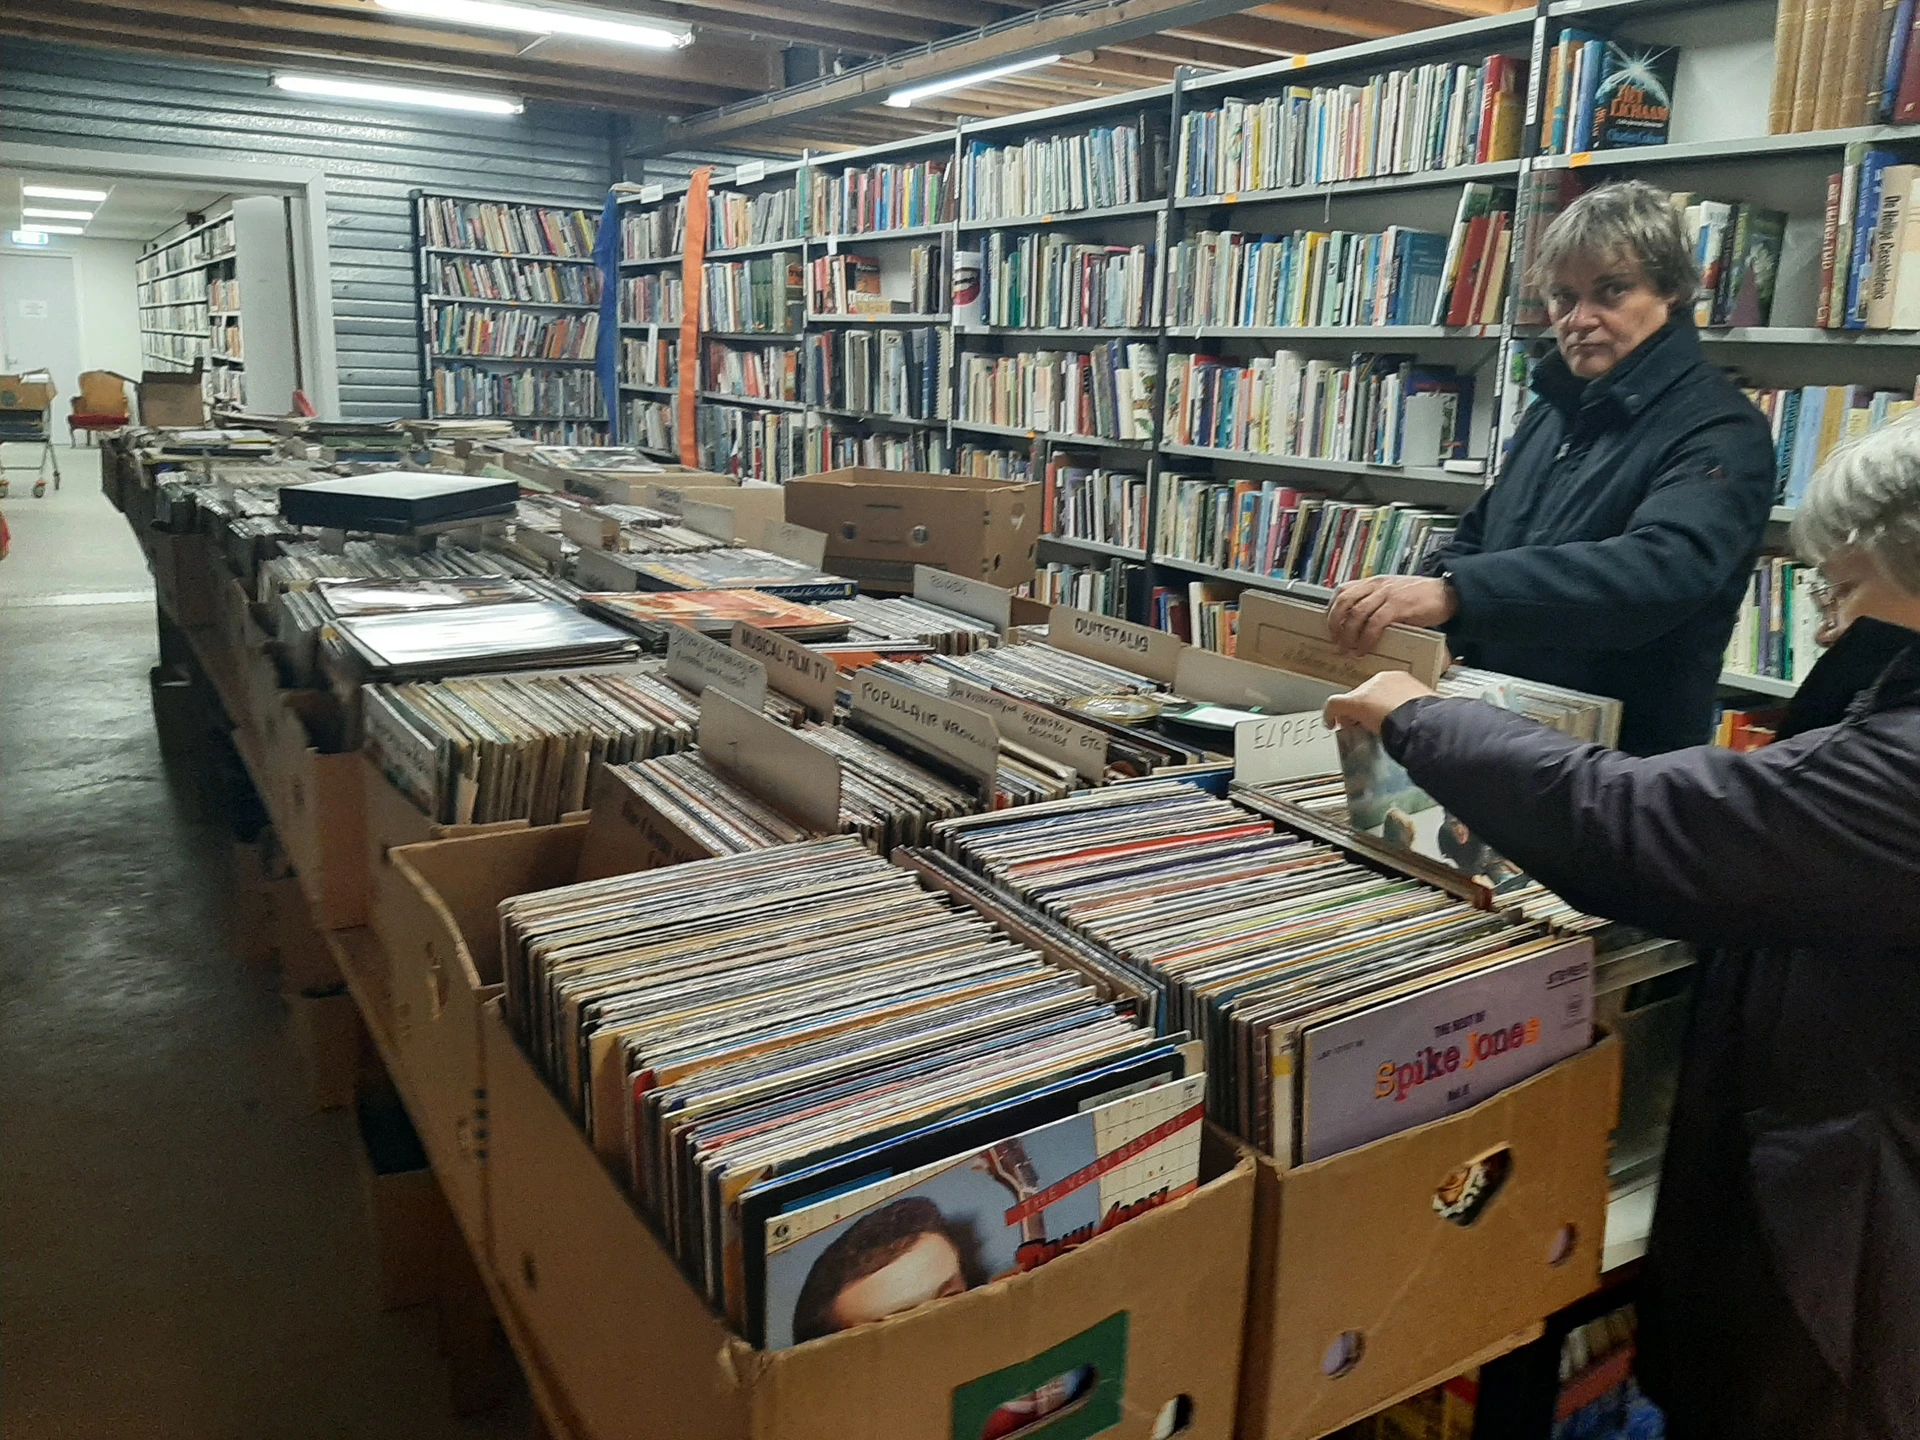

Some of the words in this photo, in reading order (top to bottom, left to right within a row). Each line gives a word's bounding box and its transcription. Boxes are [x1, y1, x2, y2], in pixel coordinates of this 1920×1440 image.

[814, 661, 828, 683] TV
[861, 681, 938, 728] POPULAIR
[1374, 1045, 1461, 1102] Spike
[1464, 1016, 1542, 1069] Jones
[1024, 1188, 1057, 1215] THE
[1067, 1156, 1110, 1187] VERY
[1118, 1130, 1159, 1161] BEST
[1166, 1114, 1188, 1134] OF
